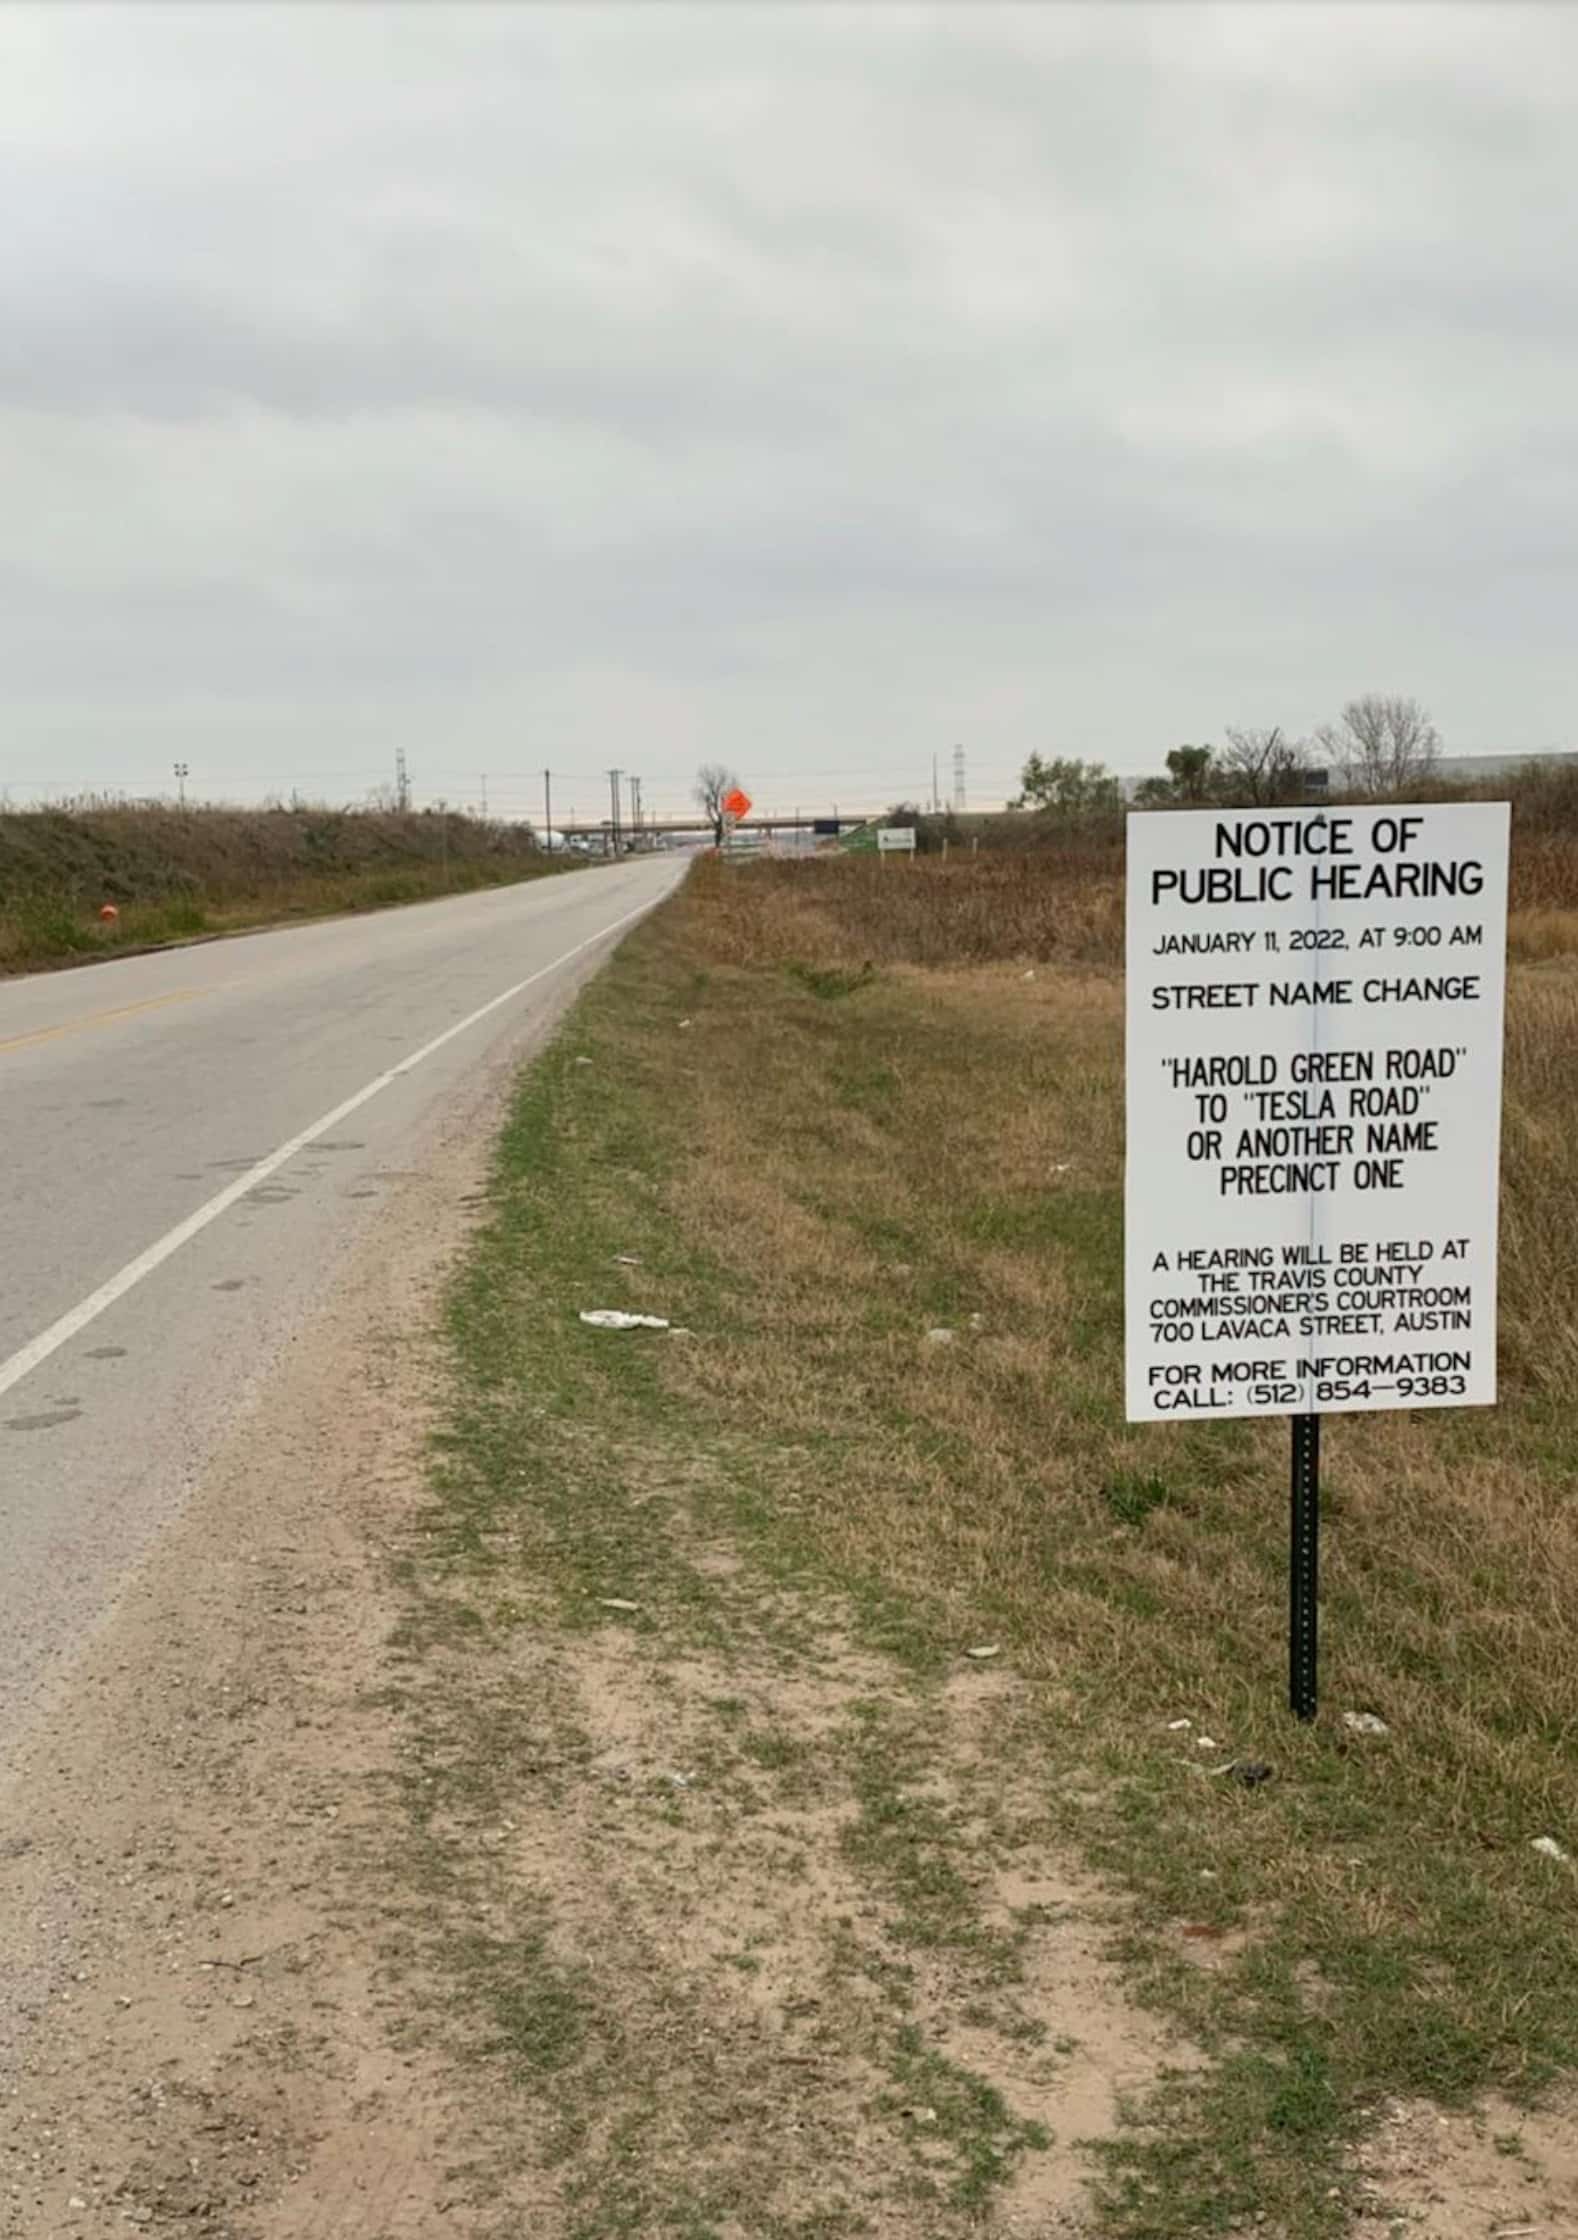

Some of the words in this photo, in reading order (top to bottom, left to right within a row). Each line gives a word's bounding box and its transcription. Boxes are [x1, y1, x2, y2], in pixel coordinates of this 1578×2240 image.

[1216, 819, 1353, 857] NOTICE
[1371, 818, 1423, 853] OF
[1153, 868, 1292, 904] PUBLIC
[1311, 862, 1483, 901] HEARING
[1153, 932, 1256, 954] JANUARY
[1359, 928, 1385, 947] AT
[1393, 926, 1441, 946] 9:00
[1449, 925, 1482, 945] AM
[1152, 984, 1259, 1009] STREET
[1270, 981, 1352, 1006] NAME
[1363, 977, 1480, 1002] CHANGE
[1162, 1056, 1277, 1088] "HAROLD
[1291, 1052, 1373, 1082] GREEN
[1386, 1047, 1466, 1079] ROAD"
[1195, 1093, 1227, 1123] TO
[1245, 1090, 1335, 1120] "TESLA
[1350, 1086, 1430, 1117] ROAD"
[1187, 1130, 1222, 1161] OR
[1237, 1126, 1353, 1157] ANOTHER
[1367, 1122, 1438, 1153] NAME
[1221, 1163, 1339, 1195] PRECINCT
[1354, 1160, 1403, 1189] ONE
[1153, 1252, 1168, 1272] A
[1178, 1248, 1273, 1270] HEARING
[1281, 1245, 1332, 1266] WILL
[1340, 1244, 1368, 1263] BE
[1376, 1242, 1433, 1262] HELD
[1442, 1239, 1470, 1259] AT
[1199, 1273, 1240, 1293] THE
[1248, 1270, 1326, 1291] TRAVIS
[1334, 1265, 1423, 1287] COUNTY
[1150, 1293, 1329, 1319] COMMISSIONER'S
[1337, 1287, 1471, 1311] COURTROOM
[1150, 1323, 1193, 1342] 700
[1202, 1318, 1290, 1340] LAVACA
[1394, 1311, 1471, 1332] AUSTIN
[1149, 1365, 1201, 1386] FOR
[1212, 1360, 1286, 1382] MORE
[1296, 1352, 1471, 1378] INFORMATION
[1154, 1389, 1233, 1409] CALL:
[1246, 1382, 1306, 1405] (512)
